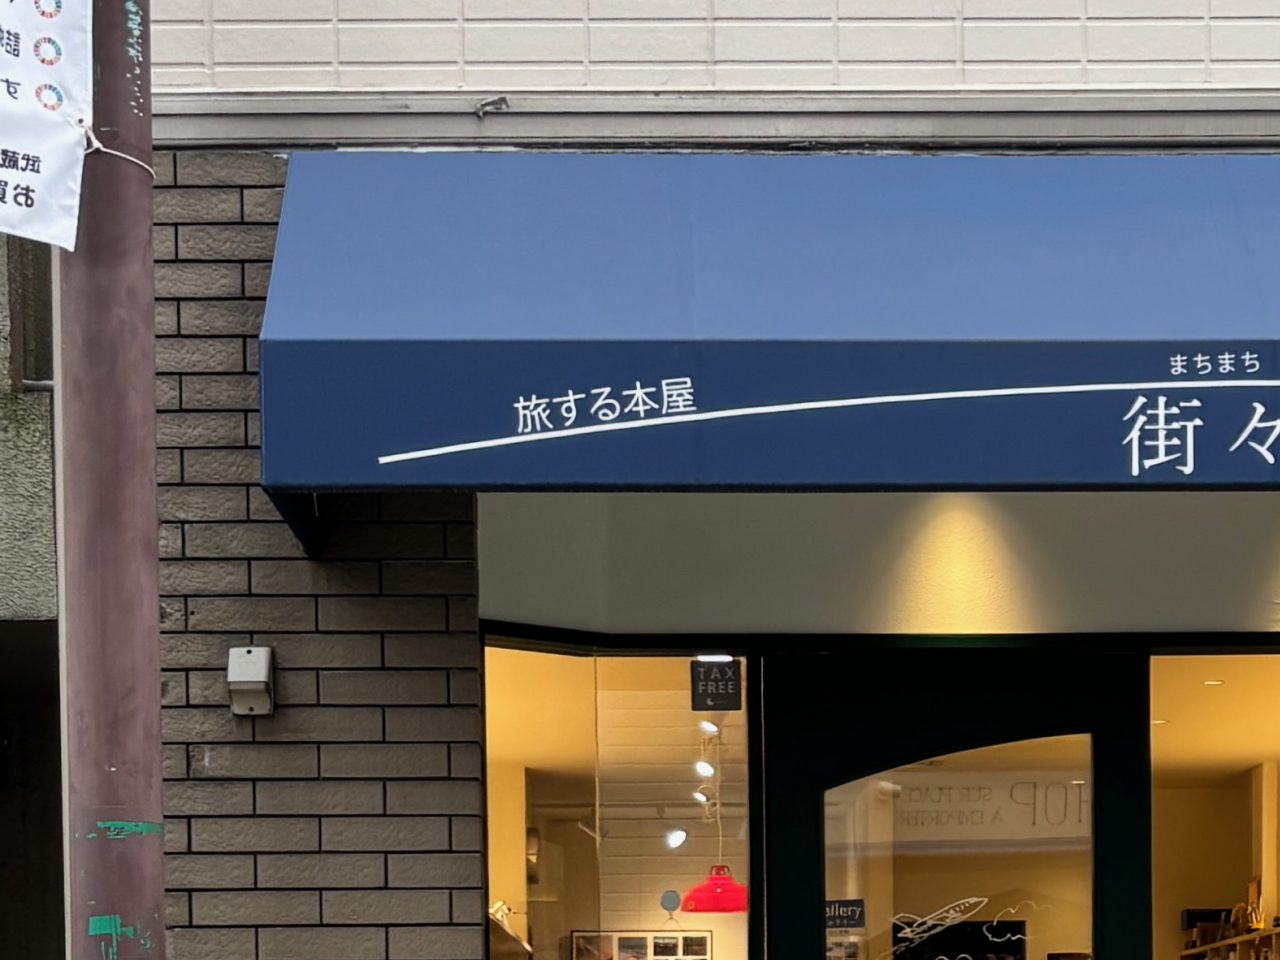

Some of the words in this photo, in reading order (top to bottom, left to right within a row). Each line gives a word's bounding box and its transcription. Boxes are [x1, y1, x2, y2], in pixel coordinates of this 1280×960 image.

[1168, 351, 1262, 375] まちまち
[512, 375, 698, 434] 旅する本屋
[697, 667, 736, 680] TAX
[697, 681, 736, 694] FREE
